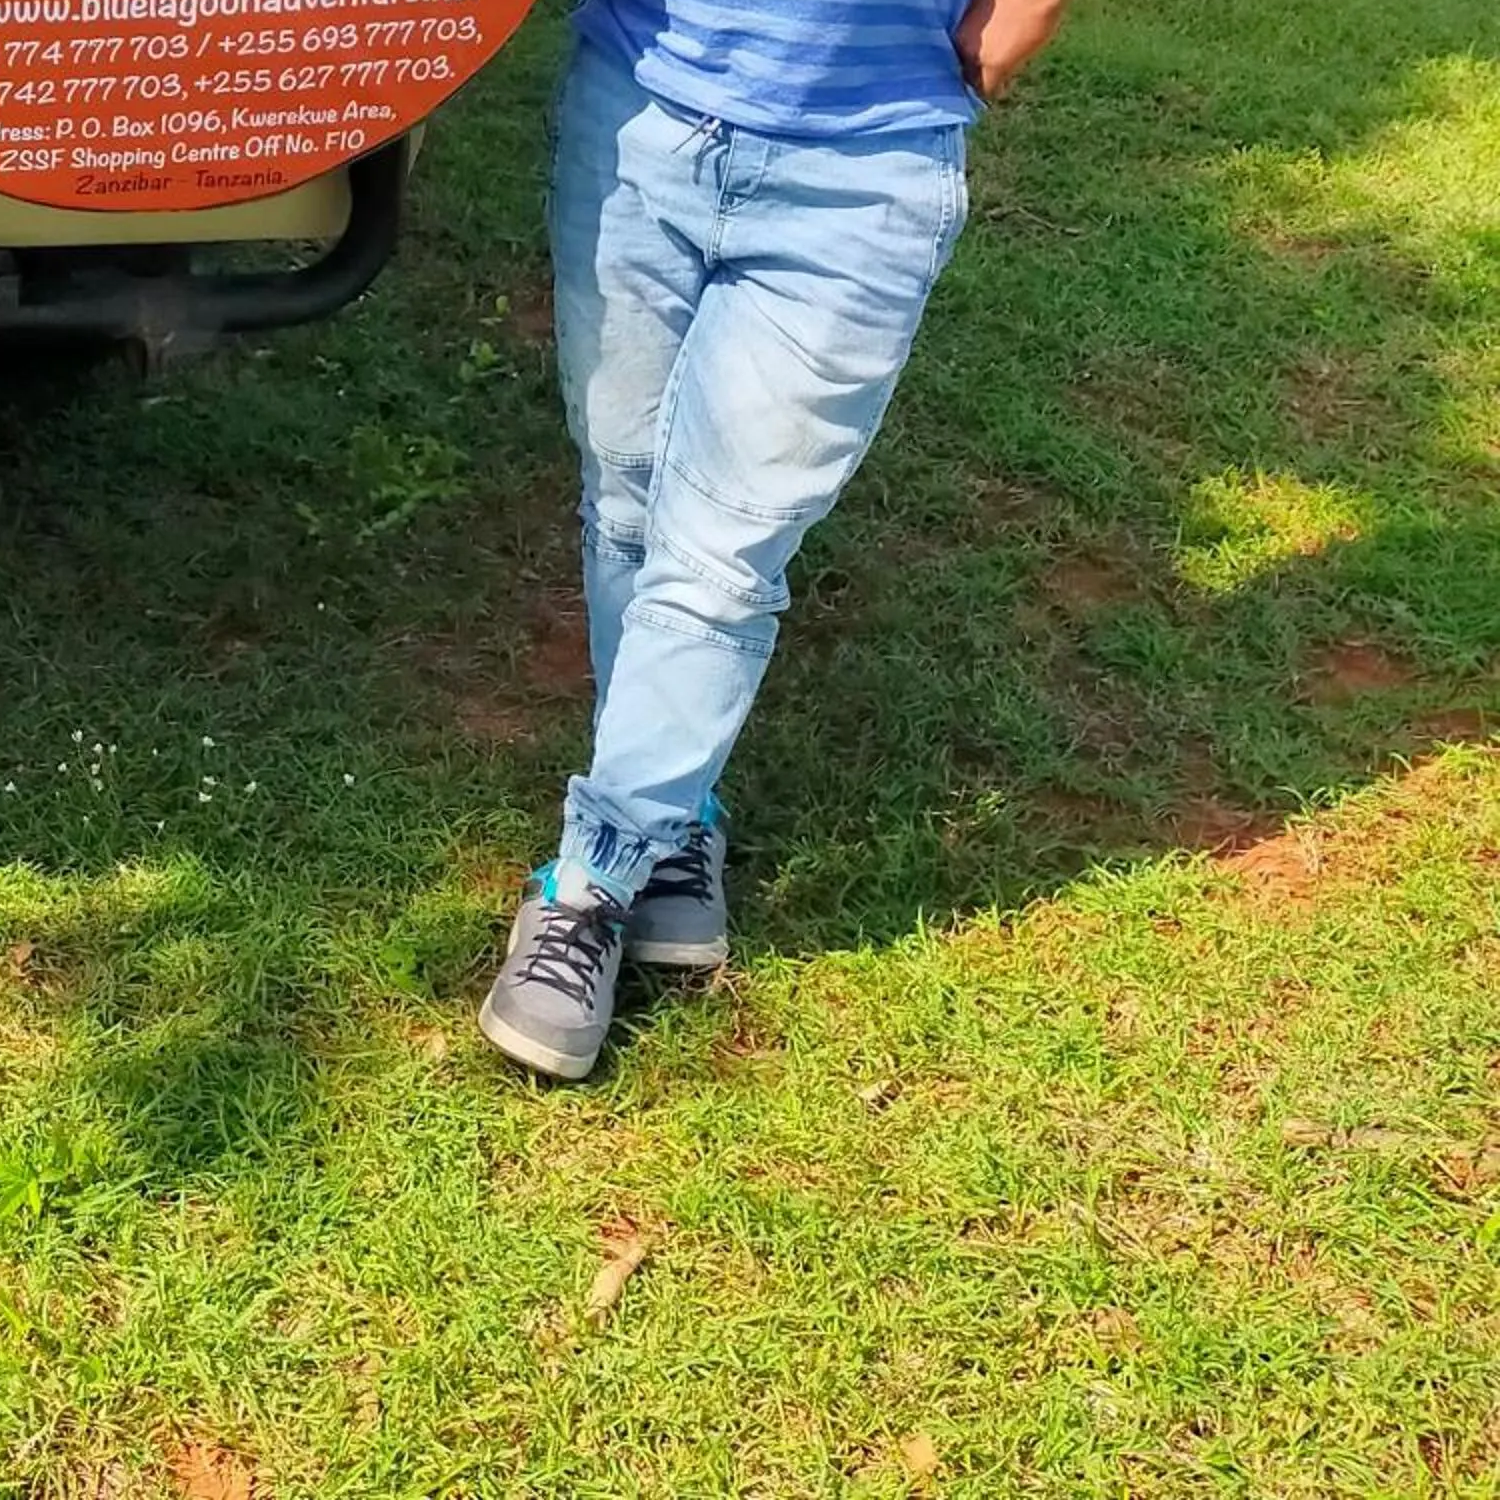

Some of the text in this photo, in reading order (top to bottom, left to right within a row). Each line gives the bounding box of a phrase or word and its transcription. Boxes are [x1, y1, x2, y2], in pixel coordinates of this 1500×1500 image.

[4, 40, 65, 67] 774
[69, 37, 124, 64] 777
[130, 34, 189, 60] 703
[196, 32, 212, 57] /
[218, 29, 297, 56] +255
[302, 24, 358, 51] 693
[364, 20, 416, 47] 777
[420, 15, 483, 44] 703,
[63, 75, 117, 103] 777
[122, 72, 188, 101] 703,
[194, 68, 272, 95] +255
[278, 64, 334, 92] 627
[339, 59, 390, 87] 777
[395, 55, 456, 83] 703.
[112, 115, 155, 137] Box
[160, 110, 227, 135] 1096,
[231, 105, 337, 129] Kwerekwe
[342, 100, 397, 123] Area,
[70, 146, 165, 173] Shopping
[171, 141, 240, 164] Centre
[244, 135, 283, 158] Off
[285, 133, 319, 156] No.
[75, 172, 172, 196] Zanzibar
[195, 167, 289, 190] Tanzania.
